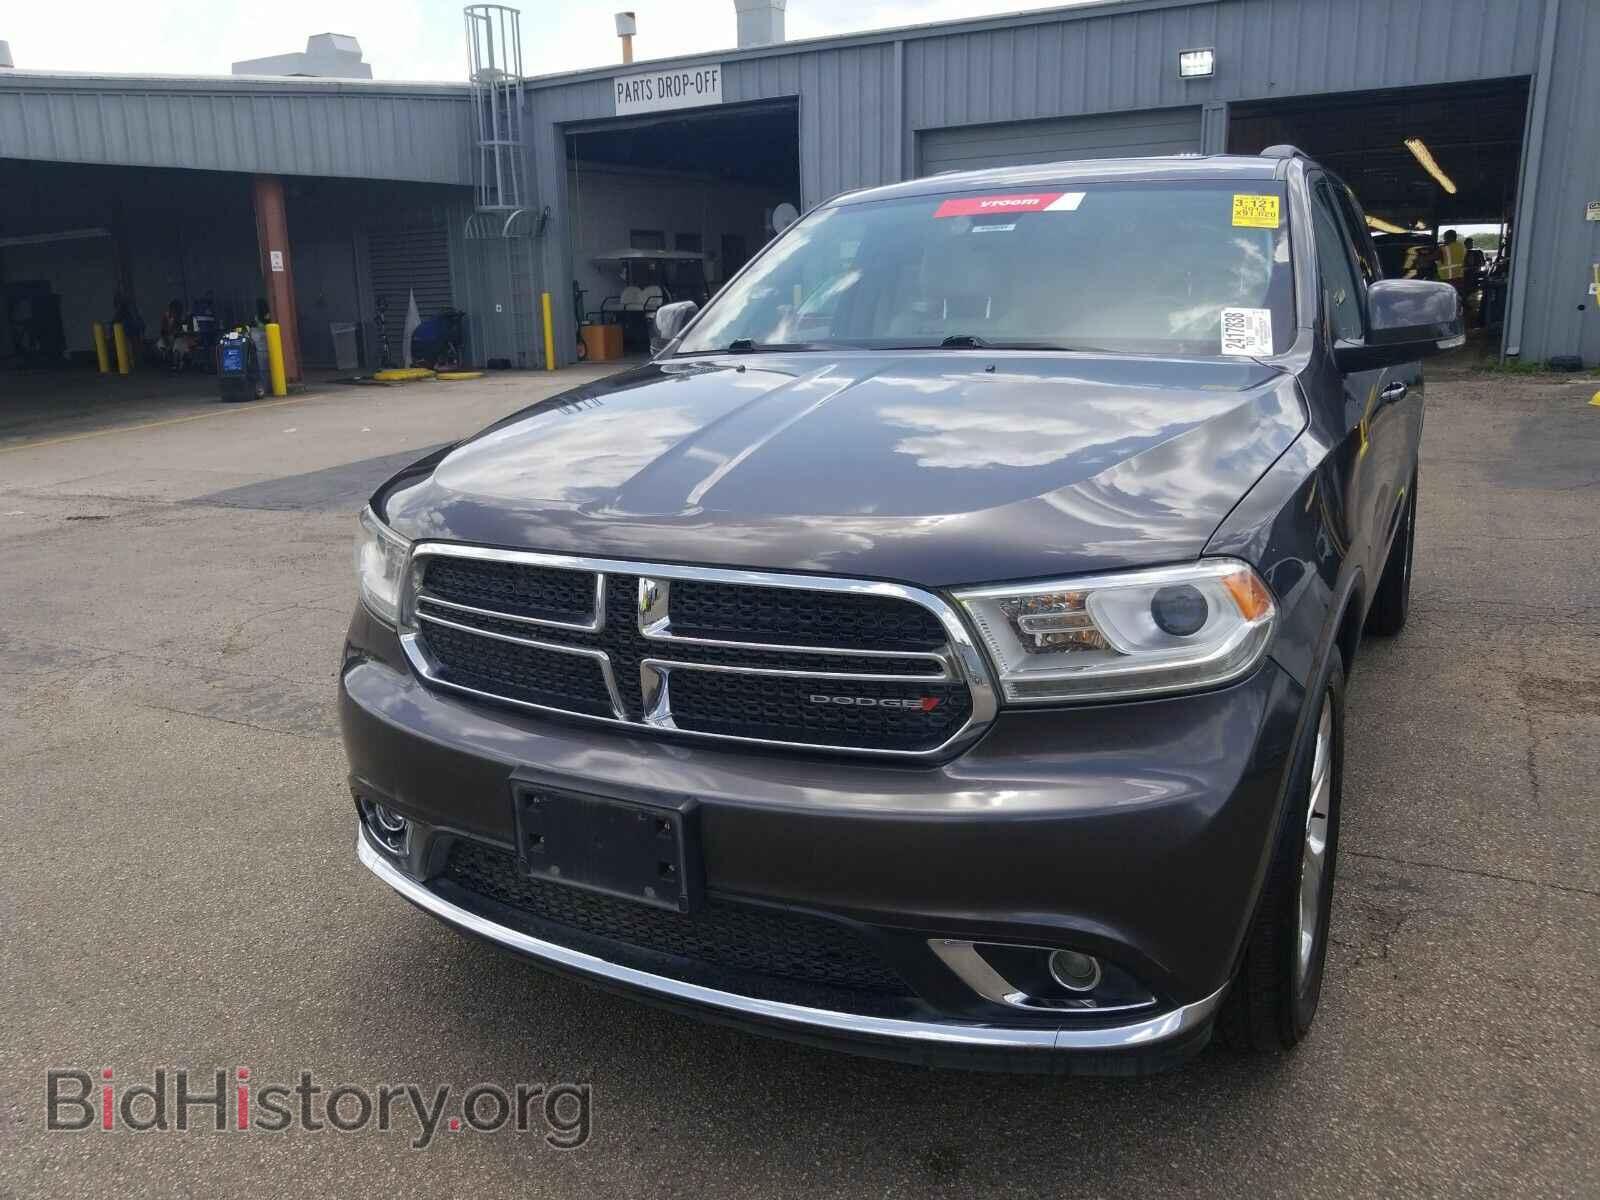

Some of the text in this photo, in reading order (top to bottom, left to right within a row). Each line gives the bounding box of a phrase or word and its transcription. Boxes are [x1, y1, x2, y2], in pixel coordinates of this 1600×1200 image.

[617, 69, 719, 104] PARTS DROP-OFF
[1223, 312, 1246, 350] 2417838
[809, 694, 923, 708] DODGE
